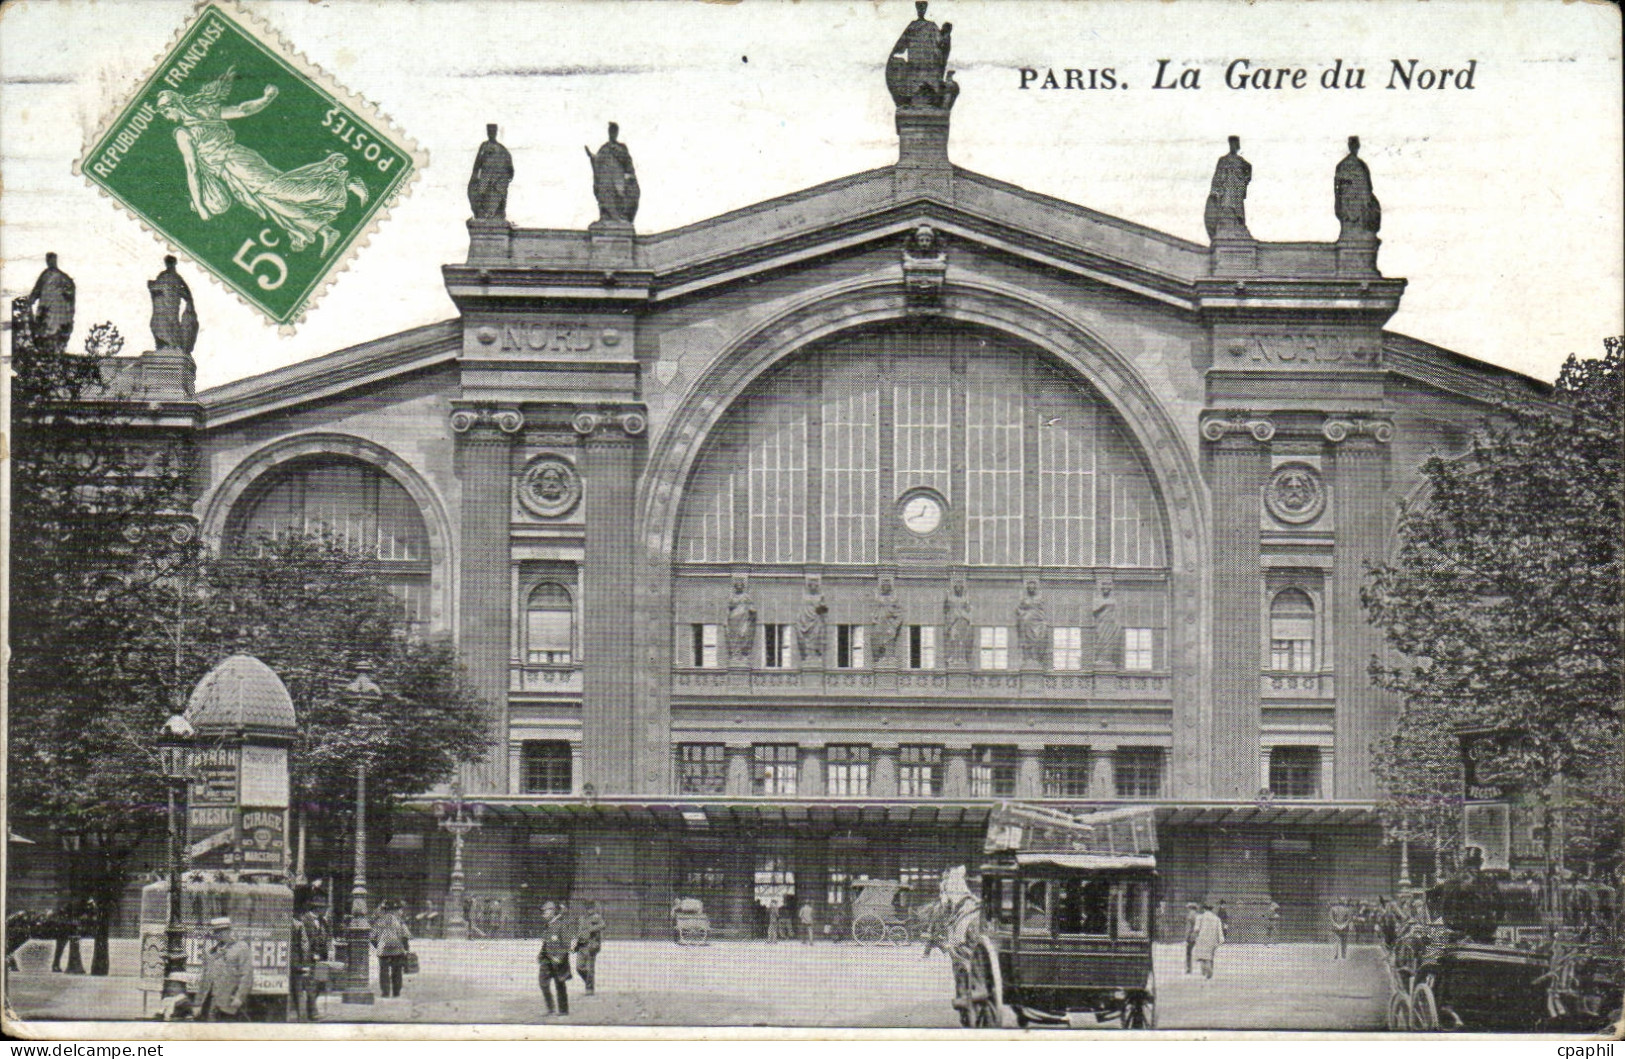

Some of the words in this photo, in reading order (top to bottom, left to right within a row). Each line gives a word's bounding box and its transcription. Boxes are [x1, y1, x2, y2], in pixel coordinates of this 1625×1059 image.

[1018, 68, 1128, 90] PARIS.
[1151, 59, 1201, 89] La
[1224, 59, 1306, 90] Gare
[1320, 59, 1366, 90] du
[1385, 59, 1477, 90] Nord
[321, 108, 395, 172] POSTES
[501, 323, 594, 351] NORD
[1251, 334, 1343, 363] NORD
[243, 811, 282, 832] CIRAGE
